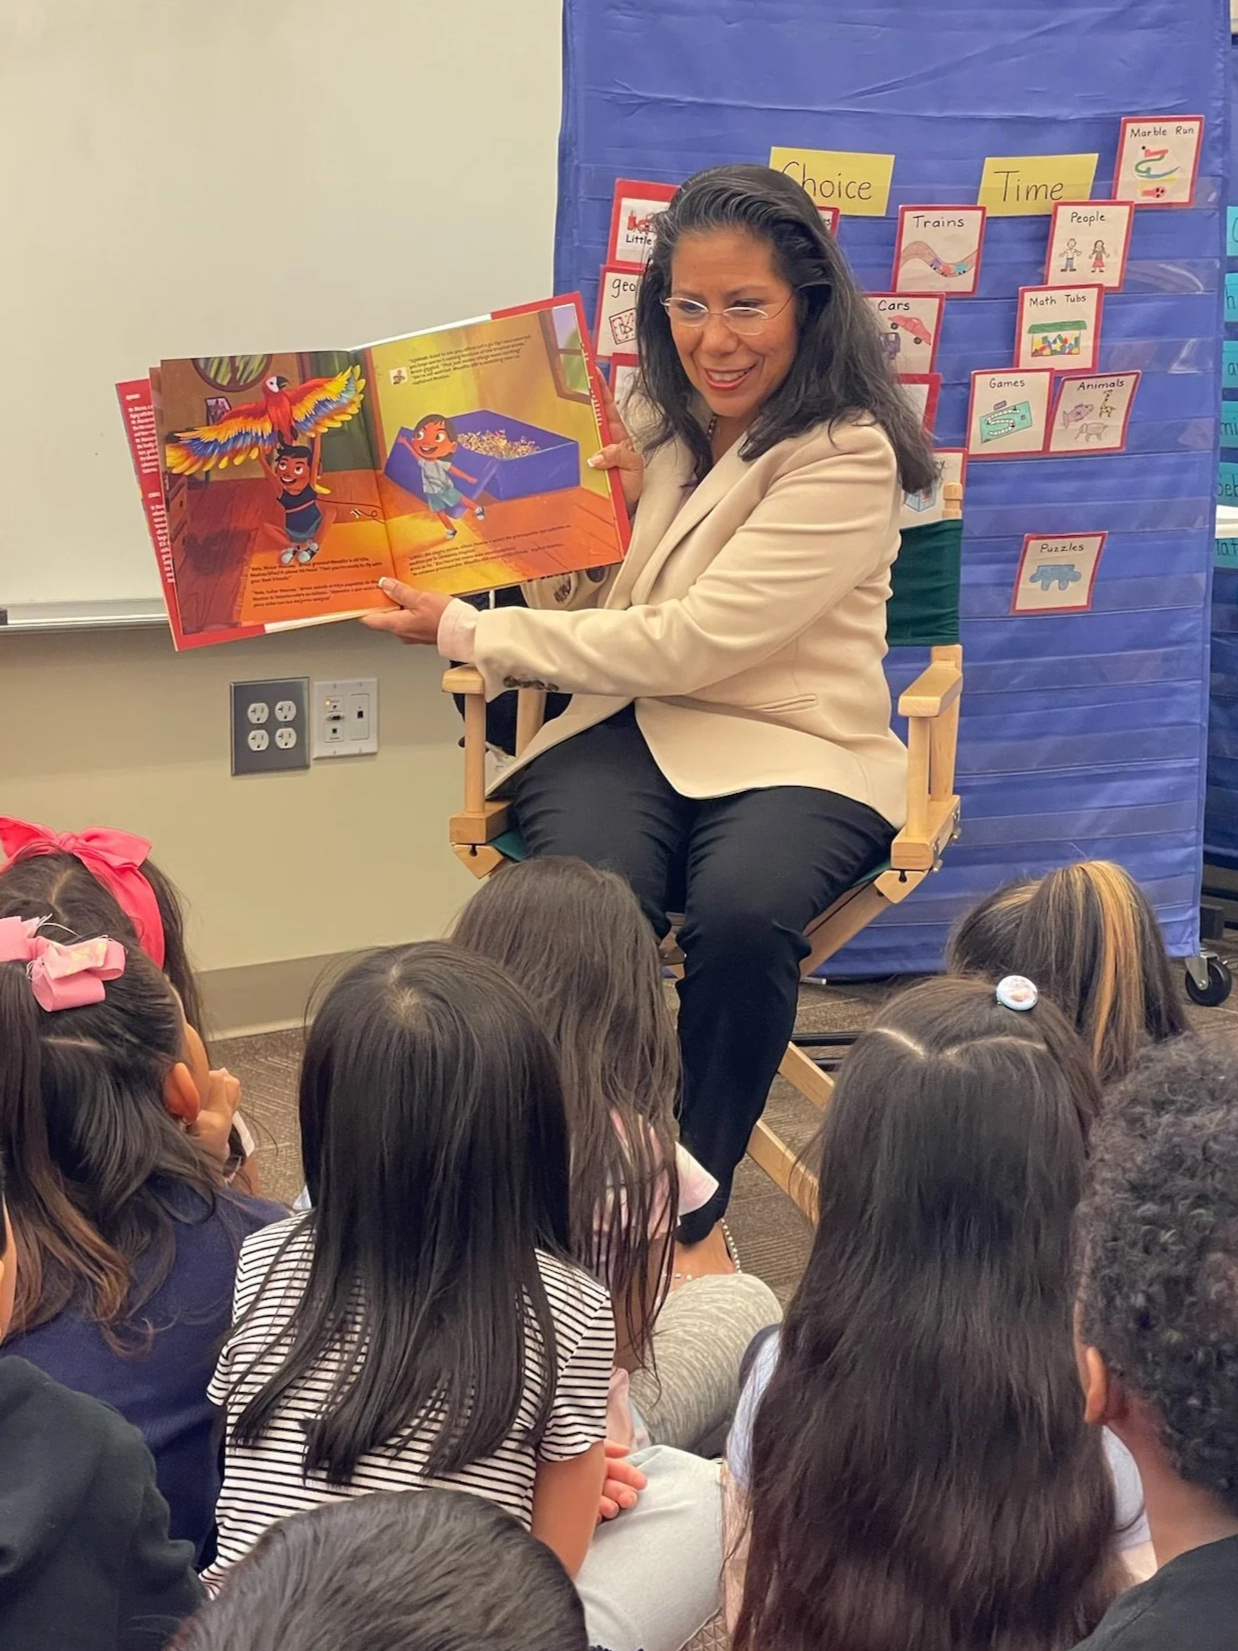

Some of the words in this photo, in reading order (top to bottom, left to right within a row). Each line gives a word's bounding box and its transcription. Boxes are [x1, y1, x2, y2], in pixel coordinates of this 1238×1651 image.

[1129, 125, 1168, 139] Marble
[1174, 125, 1195, 136] Run
[993, 169, 1065, 202] Time
[912, 214, 965, 229] Trains
[1069, 210, 1107, 227] People
[624, 233, 653, 246] Little
[877, 299, 911, 312] Cars
[1028, 296, 1057, 308] Math
[1064, 293, 1087, 304] Tubs
[988, 377, 1026, 389] Games
[1076, 377, 1126, 392] Animals
[1039, 541, 1085, 554] Puzzles
